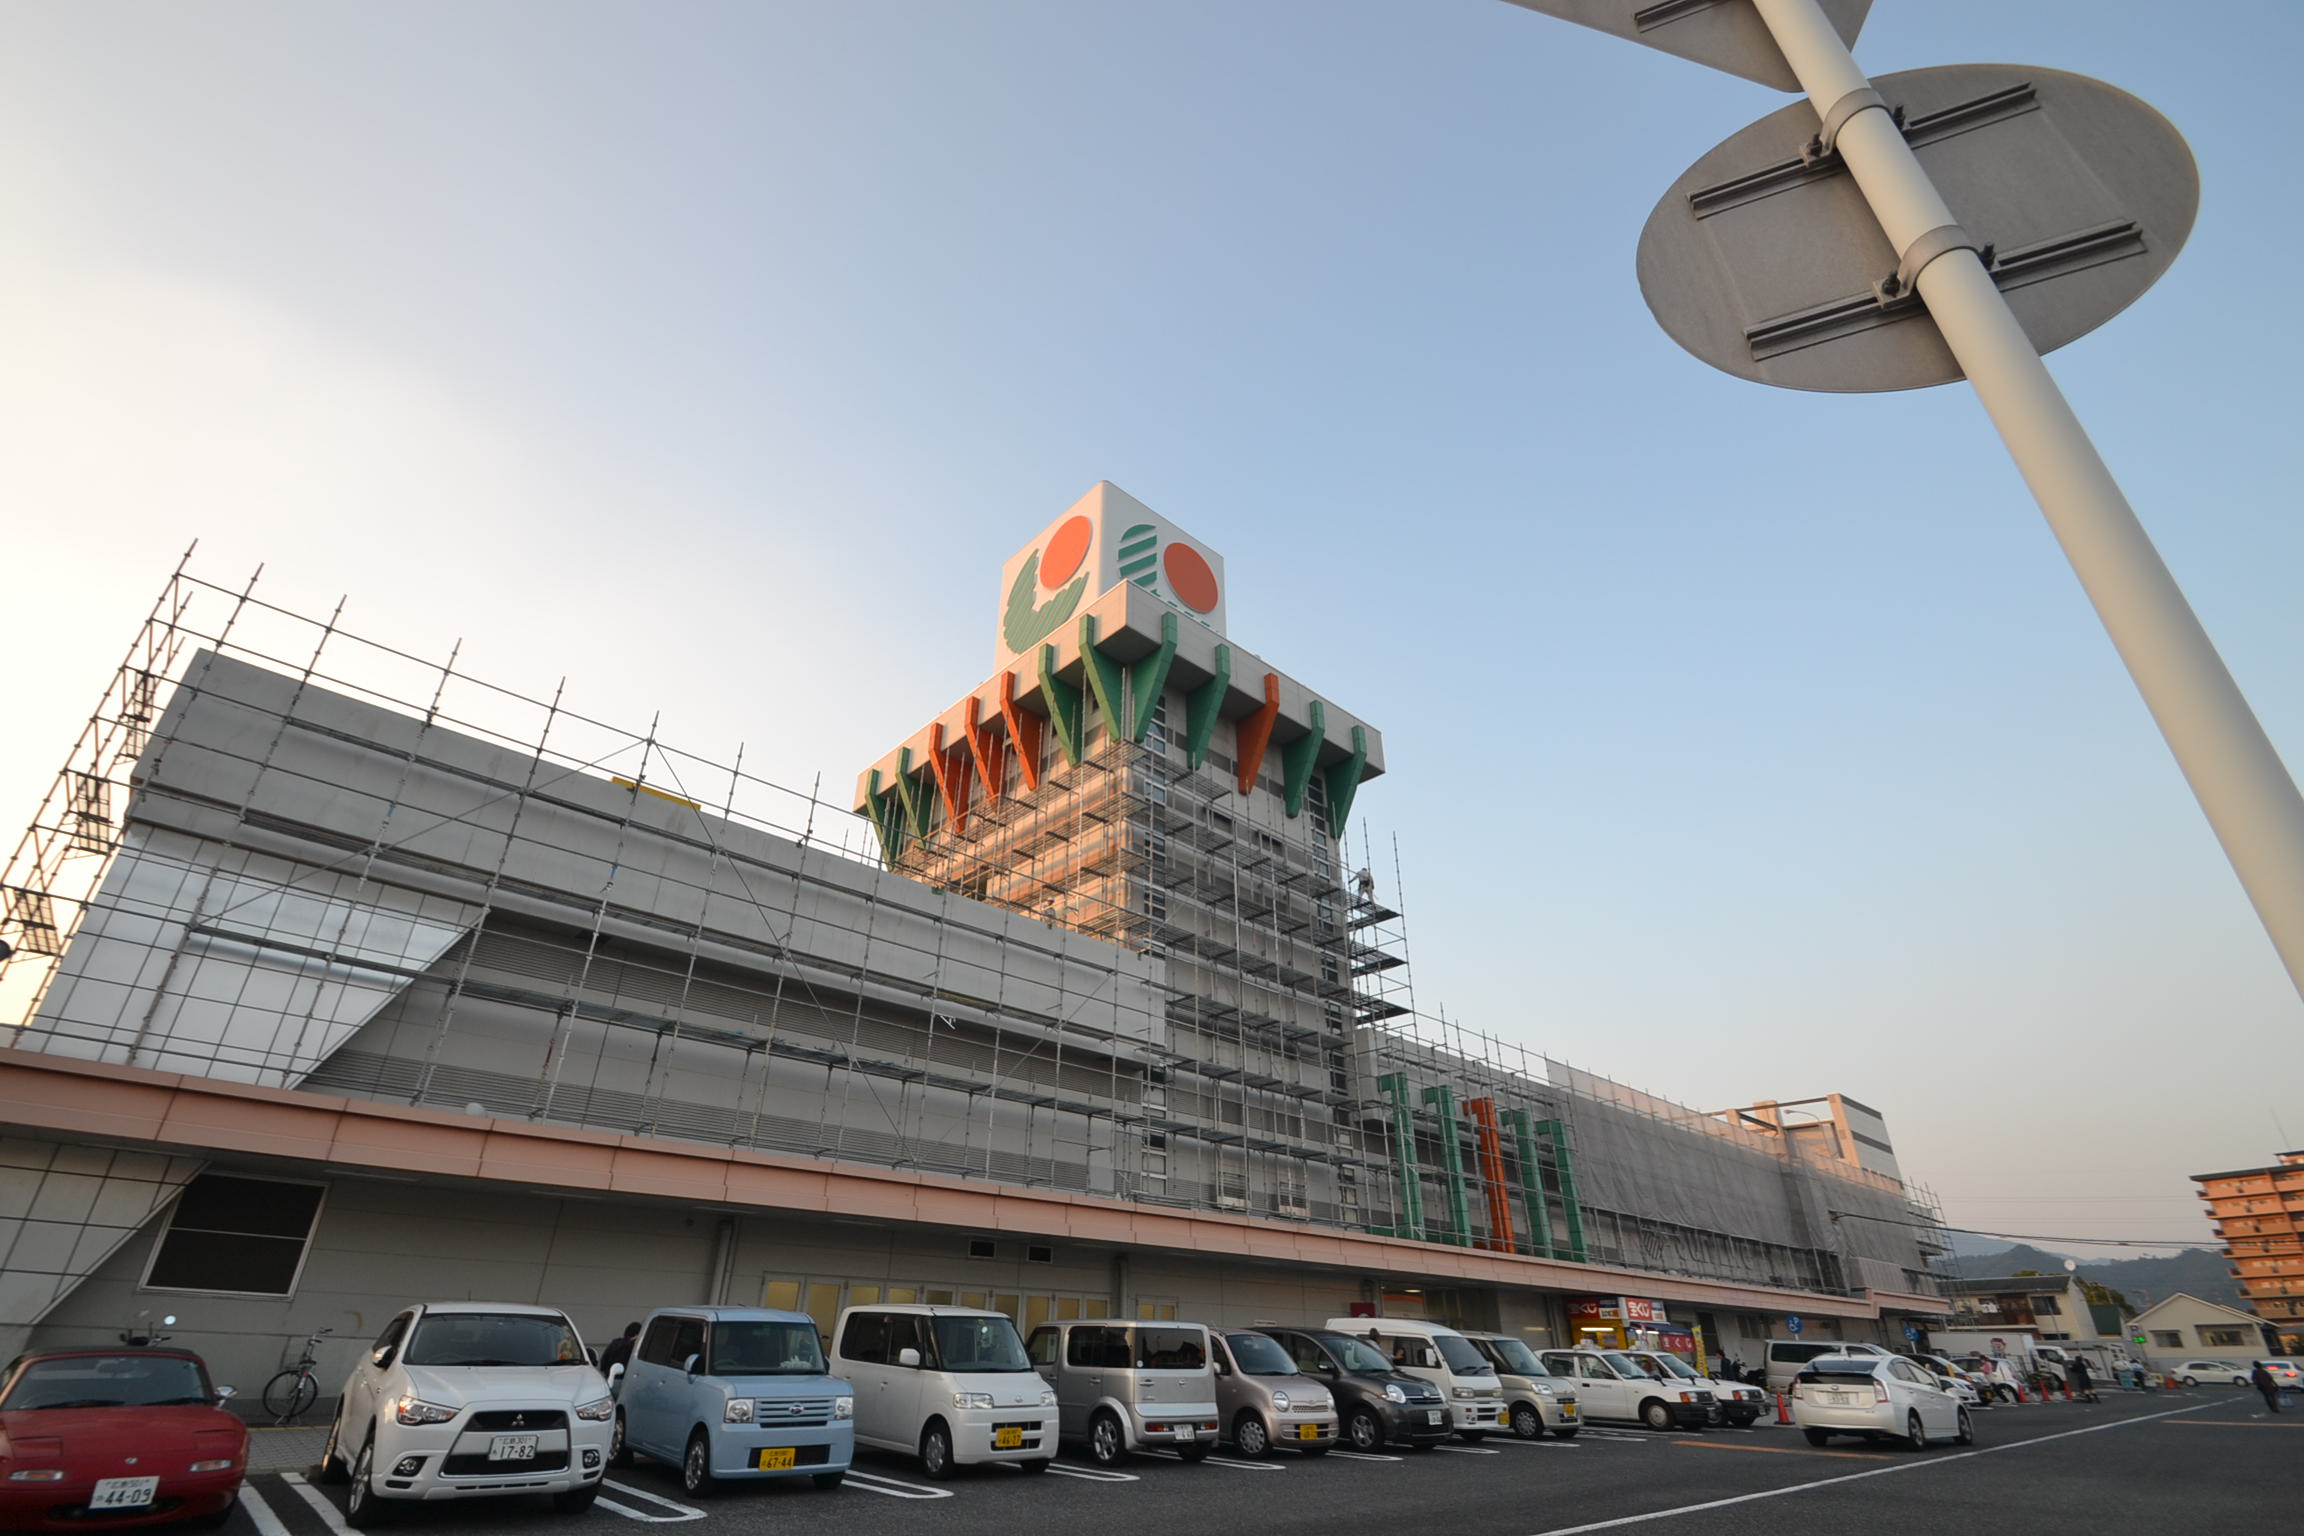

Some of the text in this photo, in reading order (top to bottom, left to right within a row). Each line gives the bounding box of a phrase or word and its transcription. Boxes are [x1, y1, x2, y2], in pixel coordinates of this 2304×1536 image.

[500, 1445, 534, 1459] 17-82
[767, 1456, 793, 1468] 67-44
[105, 1488, 152, 1504] 44-09
